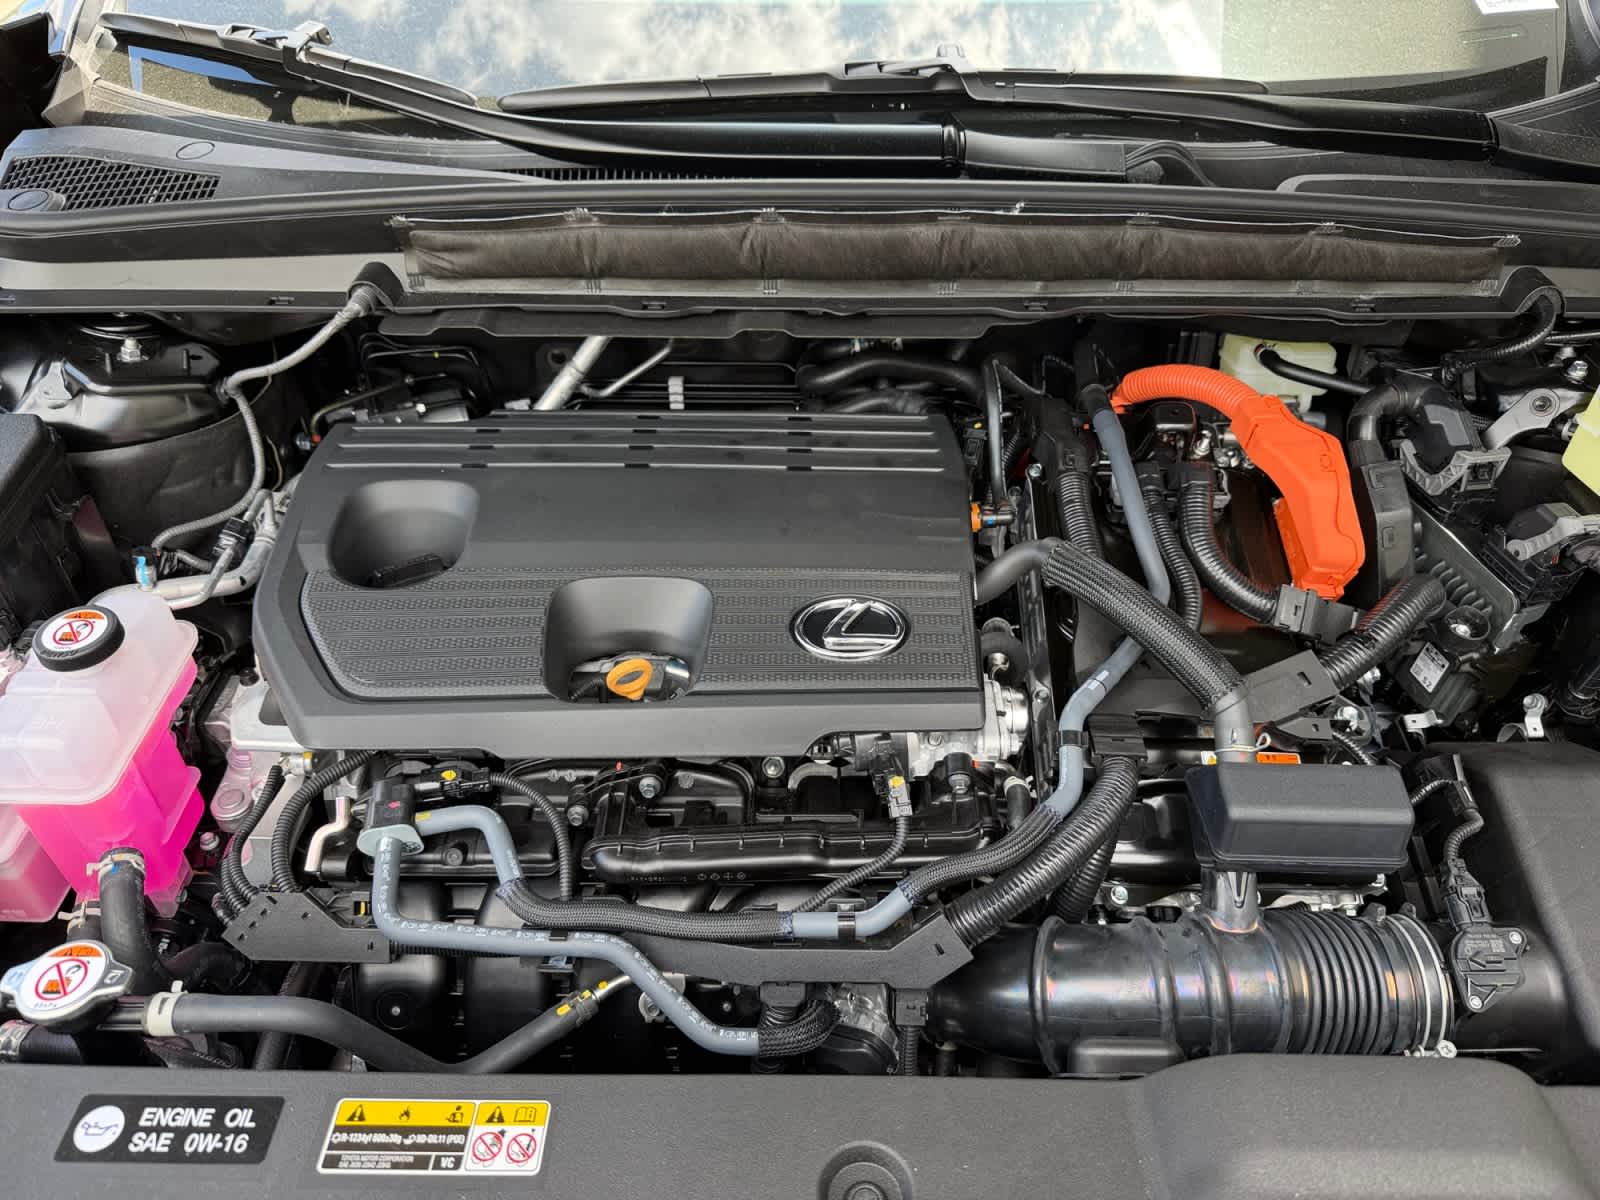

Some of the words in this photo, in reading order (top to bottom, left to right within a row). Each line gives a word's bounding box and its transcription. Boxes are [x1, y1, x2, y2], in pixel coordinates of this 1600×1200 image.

[138, 1107, 216, 1128] ENGINE
[224, 1108, 256, 1128] OIL
[128, 1132, 175, 1152] SAE
[184, 1132, 250, 1154] 0W-16
